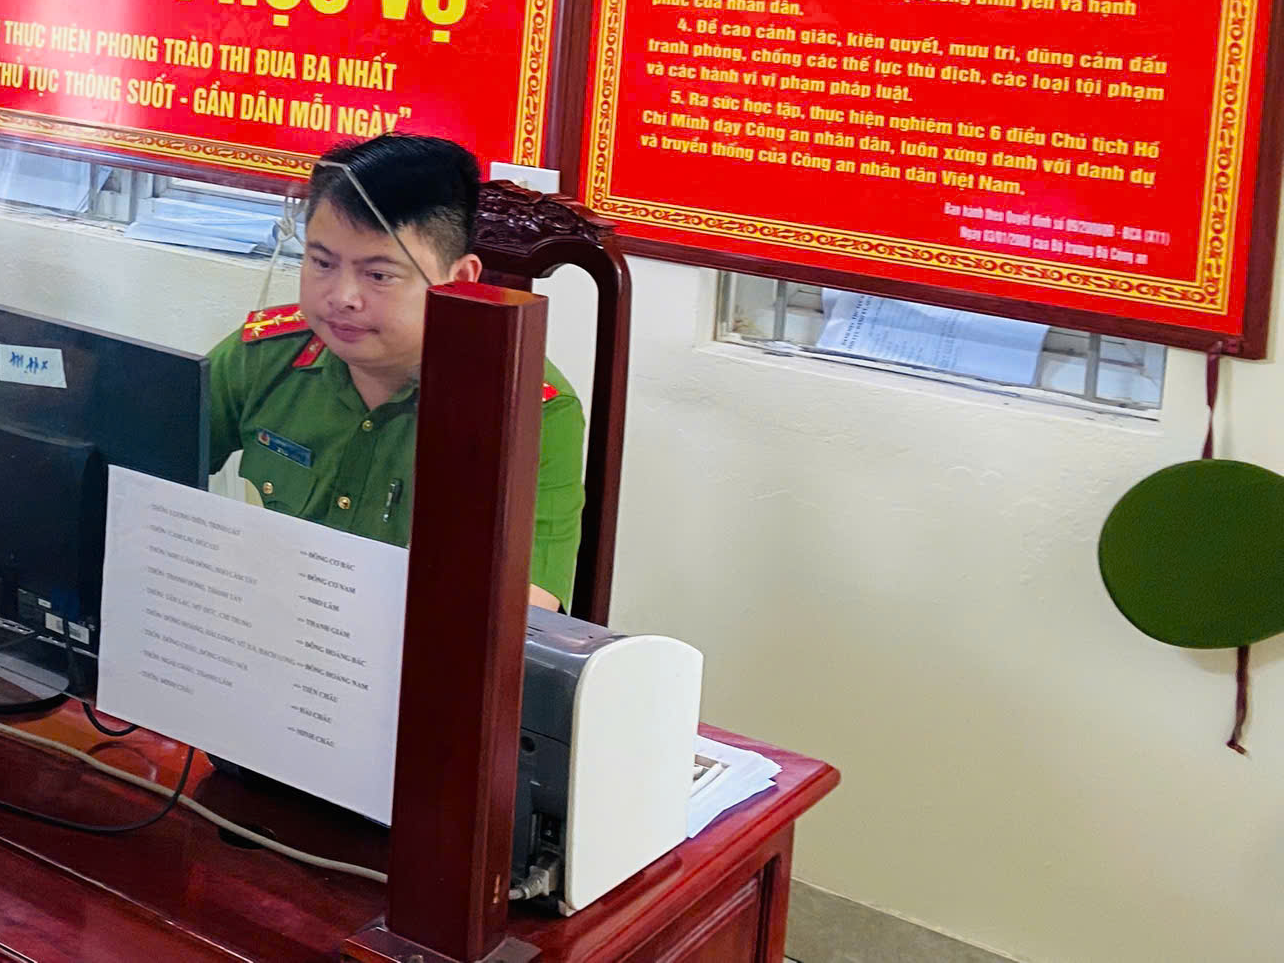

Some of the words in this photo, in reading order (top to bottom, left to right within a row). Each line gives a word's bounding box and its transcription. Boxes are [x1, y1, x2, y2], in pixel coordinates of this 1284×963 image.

[4, 21, 49, 53] THỰC
[47, 25, 93, 53] HIỆN
[94, 33, 159, 61] PHONG
[163, 38, 214, 69] TRÀO
[219, 45, 251, 77] THI
[254, 48, 296, 79] ĐUA
[301, 53, 332, 84] BA
[336, 53, 397, 90] NHẤT
[27, 66, 61, 93] TỤC
[64, 71, 124, 101] THÔNG
[125, 77, 176, 109] SUỐT
[192, 80, 236, 117] GẦN
[240, 90, 285, 125] DÂN
[289, 93, 333, 131] MỖI
